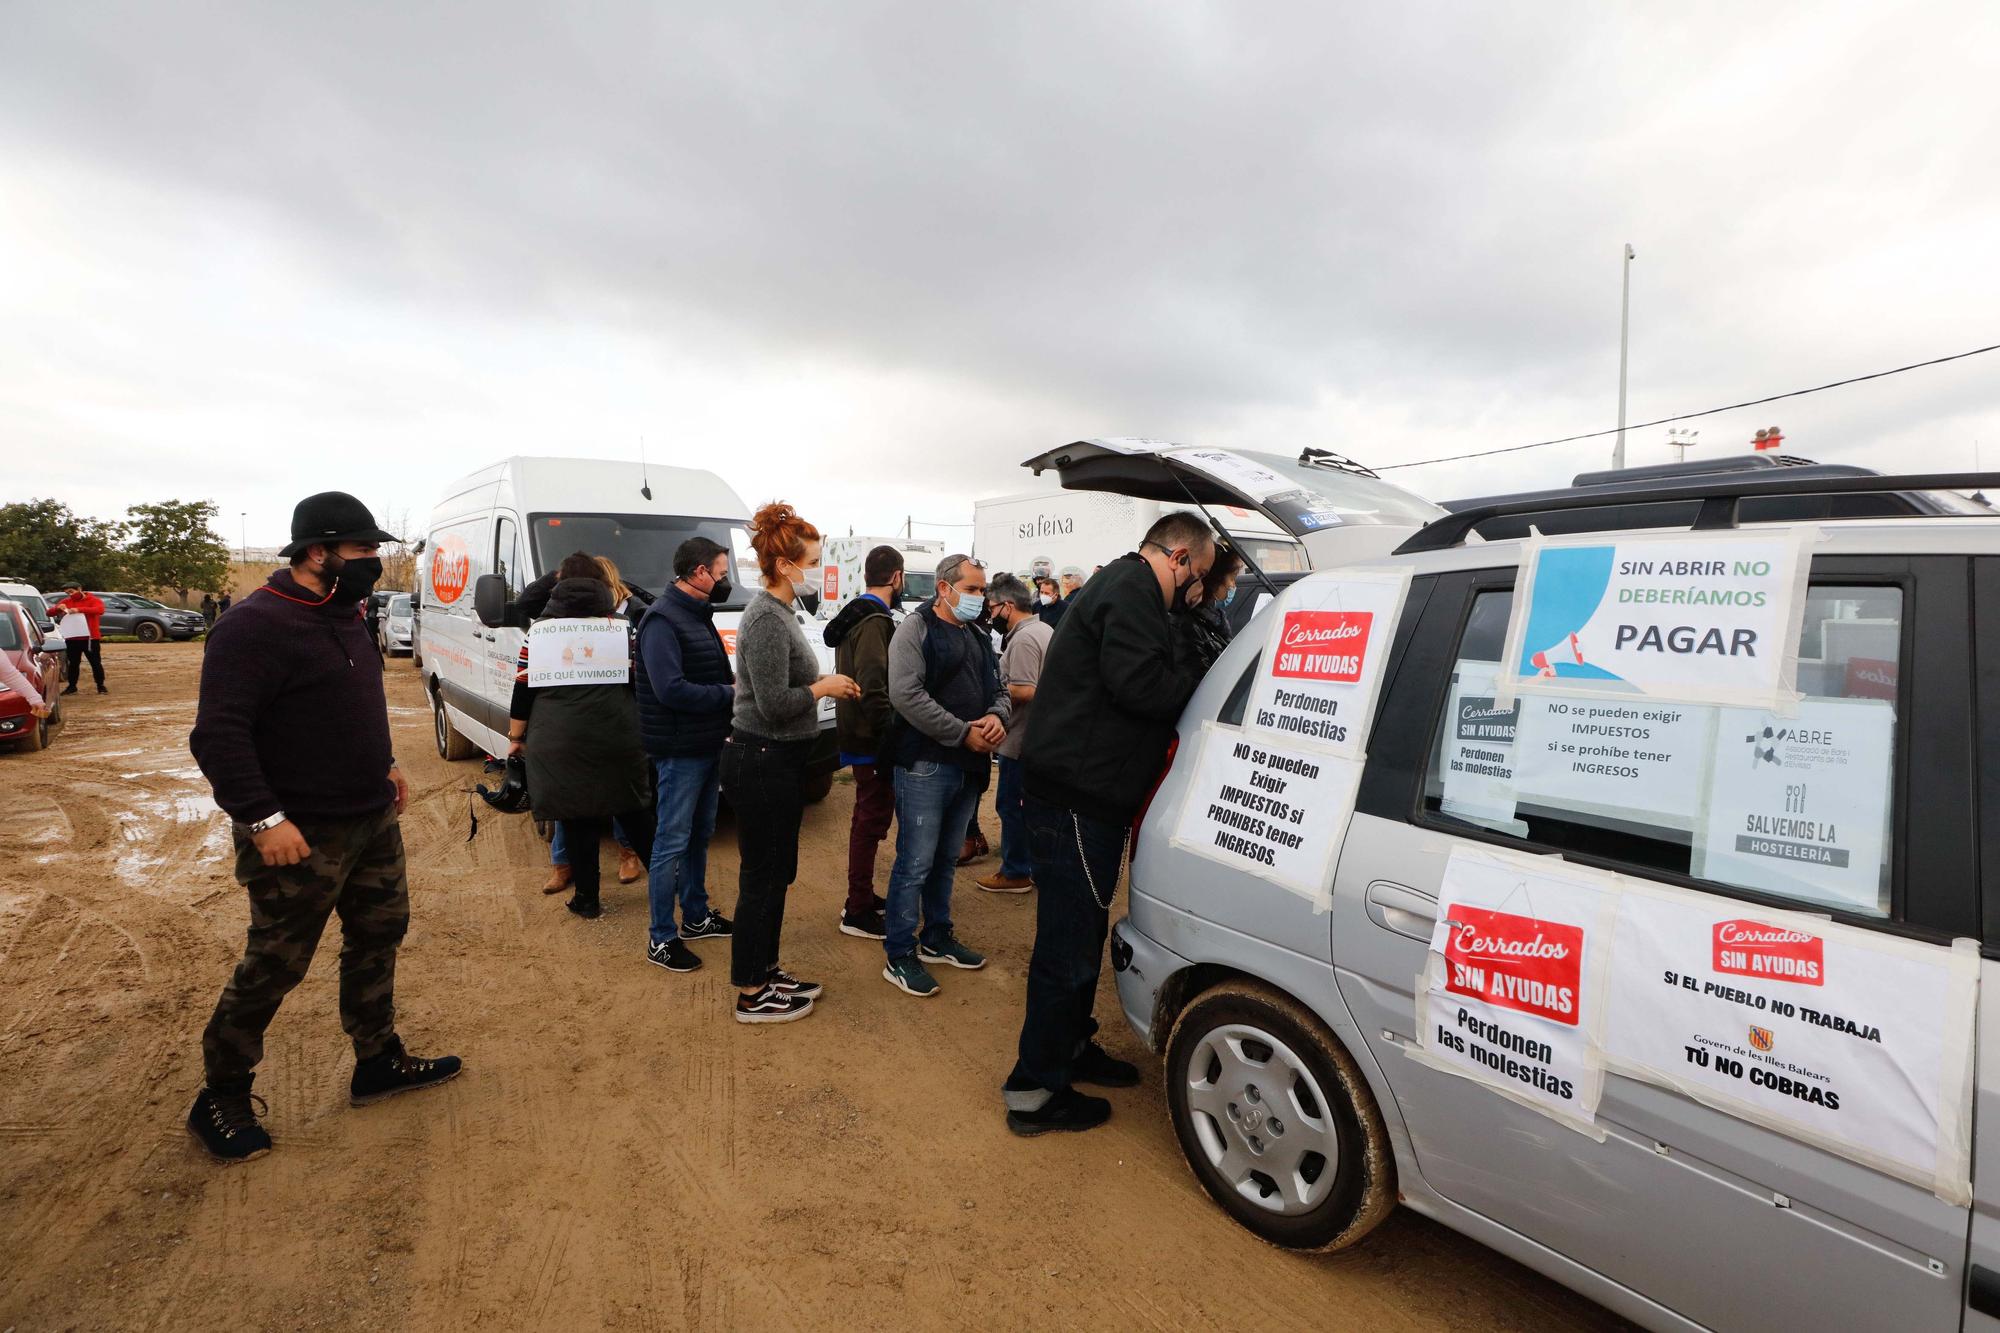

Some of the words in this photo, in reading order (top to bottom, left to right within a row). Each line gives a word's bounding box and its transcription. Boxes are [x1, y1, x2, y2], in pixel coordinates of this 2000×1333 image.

[1019, 522, 1034, 539] sa
[1620, 561, 1654, 575] SIN
[1659, 561, 1726, 576] ABRIR
[1733, 561, 1770, 577] NO
[1619, 586, 1767, 607] DEBERÍAMOS
[534, 627, 541, 635] SI
[543, 626, 557, 634] NO
[560, 624, 579, 633] HAY
[1284, 621, 1362, 645] Cerrados
[1615, 624, 1759, 657] PAGAR
[577, 669, 625, 679] VIVIMOS?!
[1280, 653, 1302, 672] SIN
[1304, 654, 1359, 675] AYUDAS
[1274, 688, 1338, 716] Perdonen
[1548, 703, 1568, 714] NO
[1572, 706, 1585, 716] se
[1589, 707, 1638, 719] pueden
[1643, 711, 1682, 724] exigir
[1256, 708, 1276, 727] las
[1277, 713, 1347, 742] molestias
[1461, 724, 1476, 736] SIN
[1478, 725, 1516, 738] AYUDAS
[1572, 723, 1650, 740] IMPUESTOS
[1786, 729, 1833, 745] A.B.R.E
[1233, 742, 1251, 760] NO
[1251, 750, 1267, 765] se
[1267, 754, 1320, 779] pueden
[1460, 746, 1505, 763] Perdonen
[1547, 741, 1558, 751] si
[1561, 744, 1575, 753] se
[1578, 745, 1630, 758] prohíbe
[1634, 751, 1672, 762] tener
[1450, 760, 1463, 771] las
[1465, 762, 1513, 779] molestias
[1572, 762, 1639, 778] INGRESOS
[1249, 770, 1288, 794] Exigir
[1219, 784, 1290, 820] IMPUESTOS
[1289, 809, 1305, 825] si
[1207, 804, 1266, 837] PROHIBES
[1265, 825, 1304, 850] tener
[1746, 814, 1815, 841] SALVEMOS
[1818, 823, 1836, 843] LA
[1214, 830, 1276, 867] INGRESOS.
[1751, 839, 1832, 863] HOSTELERÍA
[1454, 925, 1569, 959] Cerrados
[1719, 923, 1813, 943] Cerrados
[1720, 950, 1747, 970] SIN
[1752, 953, 1819, 979] AYUDAS
[1454, 964, 1485, 993] SIN
[1491, 971, 1573, 1014] AYUDAS
[1664, 971, 1678, 986] SI
[1682, 975, 1700, 992] EL
[1704, 981, 1767, 1010] PUEBLO
[1770, 999, 1795, 1018] NO
[1799, 1007, 1882, 1044] TRABAJA
[1457, 1007, 1552, 1065] Perdonen
[1437, 1024, 1465, 1053] las
[1470, 1042, 1574, 1100] molestias
[1693, 1034, 1731, 1052] Govern
[1733, 1046, 1746, 1056] de
[1748, 1049, 1763, 1062] les
[1765, 1056, 1786, 1069] Illes
[1788, 1063, 1831, 1083] Balears
[1715, 1055, 1743, 1079] NO
[1749, 1066, 1840, 1111] COBRAS
